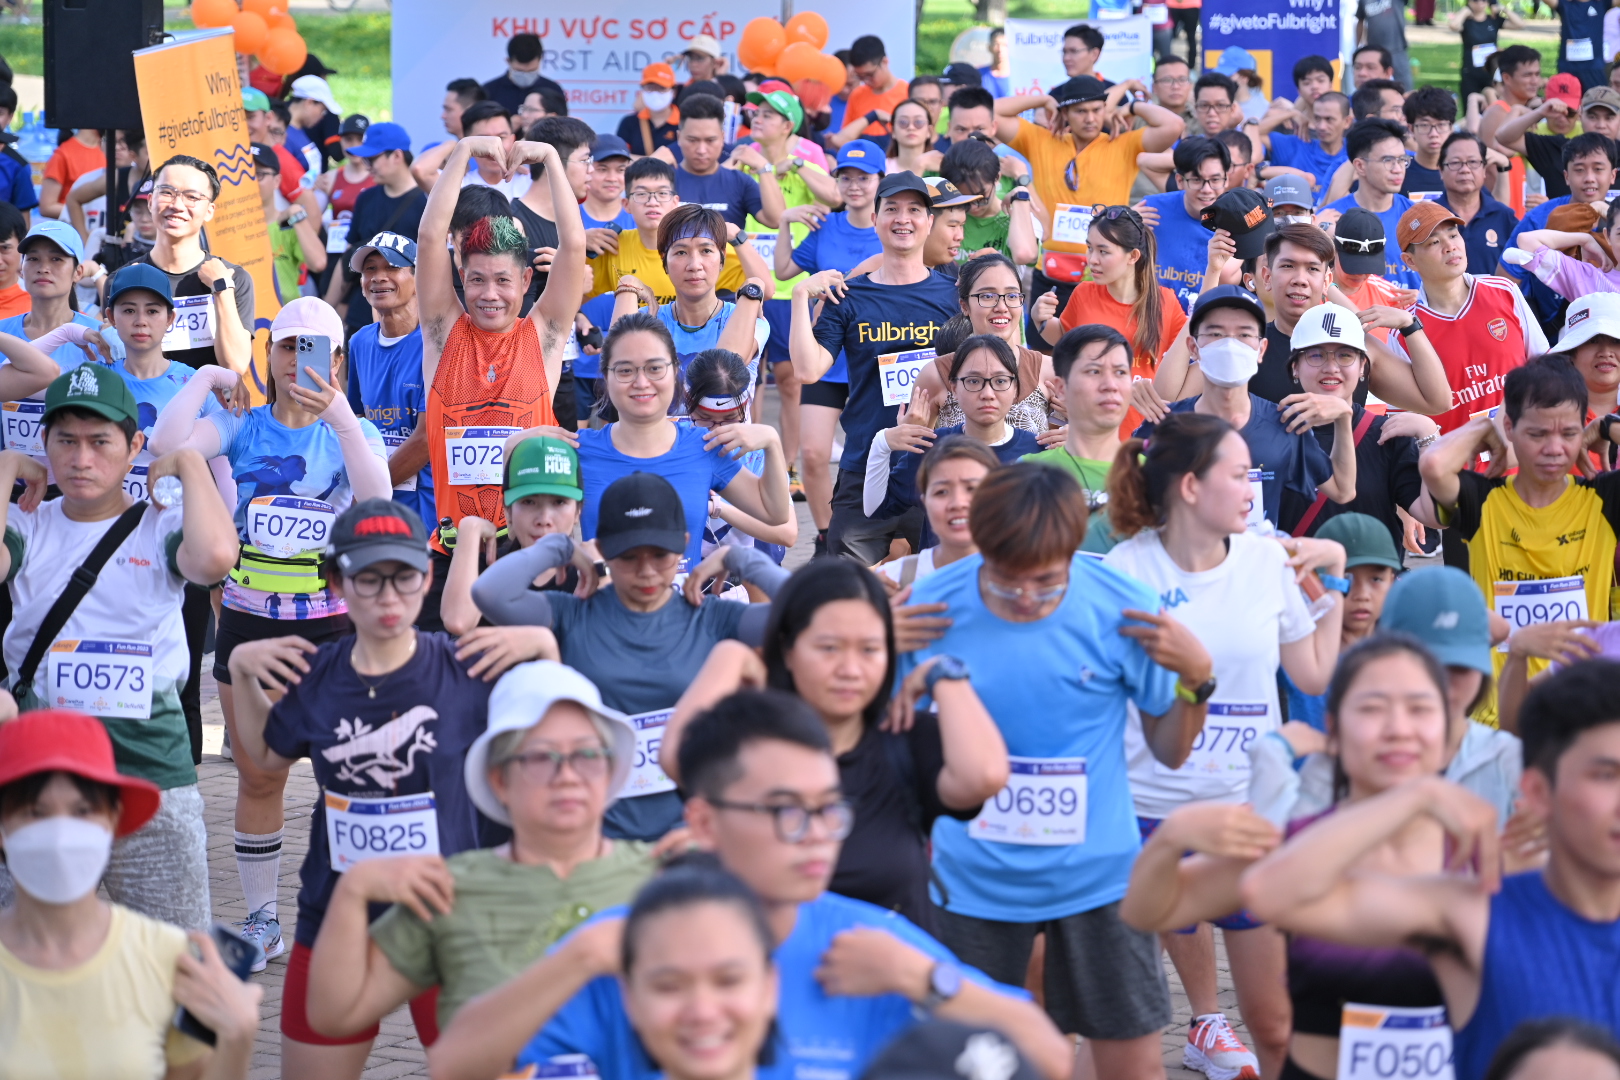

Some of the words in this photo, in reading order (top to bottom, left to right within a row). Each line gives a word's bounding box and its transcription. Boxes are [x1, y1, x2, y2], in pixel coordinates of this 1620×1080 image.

[492, 18, 550, 39] KHU
[560, 17, 621, 45] VỰC
[629, 16, 669, 40] SƠ
[678, 13, 737, 41] CẤP
[1209, 13, 1338, 34] #givetoFulbright
[541, 50, 594, 71] RST
[602, 49, 651, 72] AID
[206, 72, 233, 98] Why
[563, 88, 627, 104] BRIGHT
[1057, 214, 1090, 233] F106
[1154, 264, 1207, 288] Fulbrigh
[858, 321, 941, 346] Fulbrigh
[885, 368, 920, 389] F09
[1465, 363, 1488, 379] Fly
[1451, 374, 1507, 410] Emirat
[7, 417, 42, 438] F07
[452, 446, 503, 466] F072
[544, 461, 572, 475] HUE
[253, 512, 327, 542] F0729
[1500, 599, 1582, 628] F0920
[57, 663, 145, 693] F0573
[1191, 726, 1257, 752] 0778
[995, 786, 1078, 816] 0639
[334, 820, 428, 852] F0825
